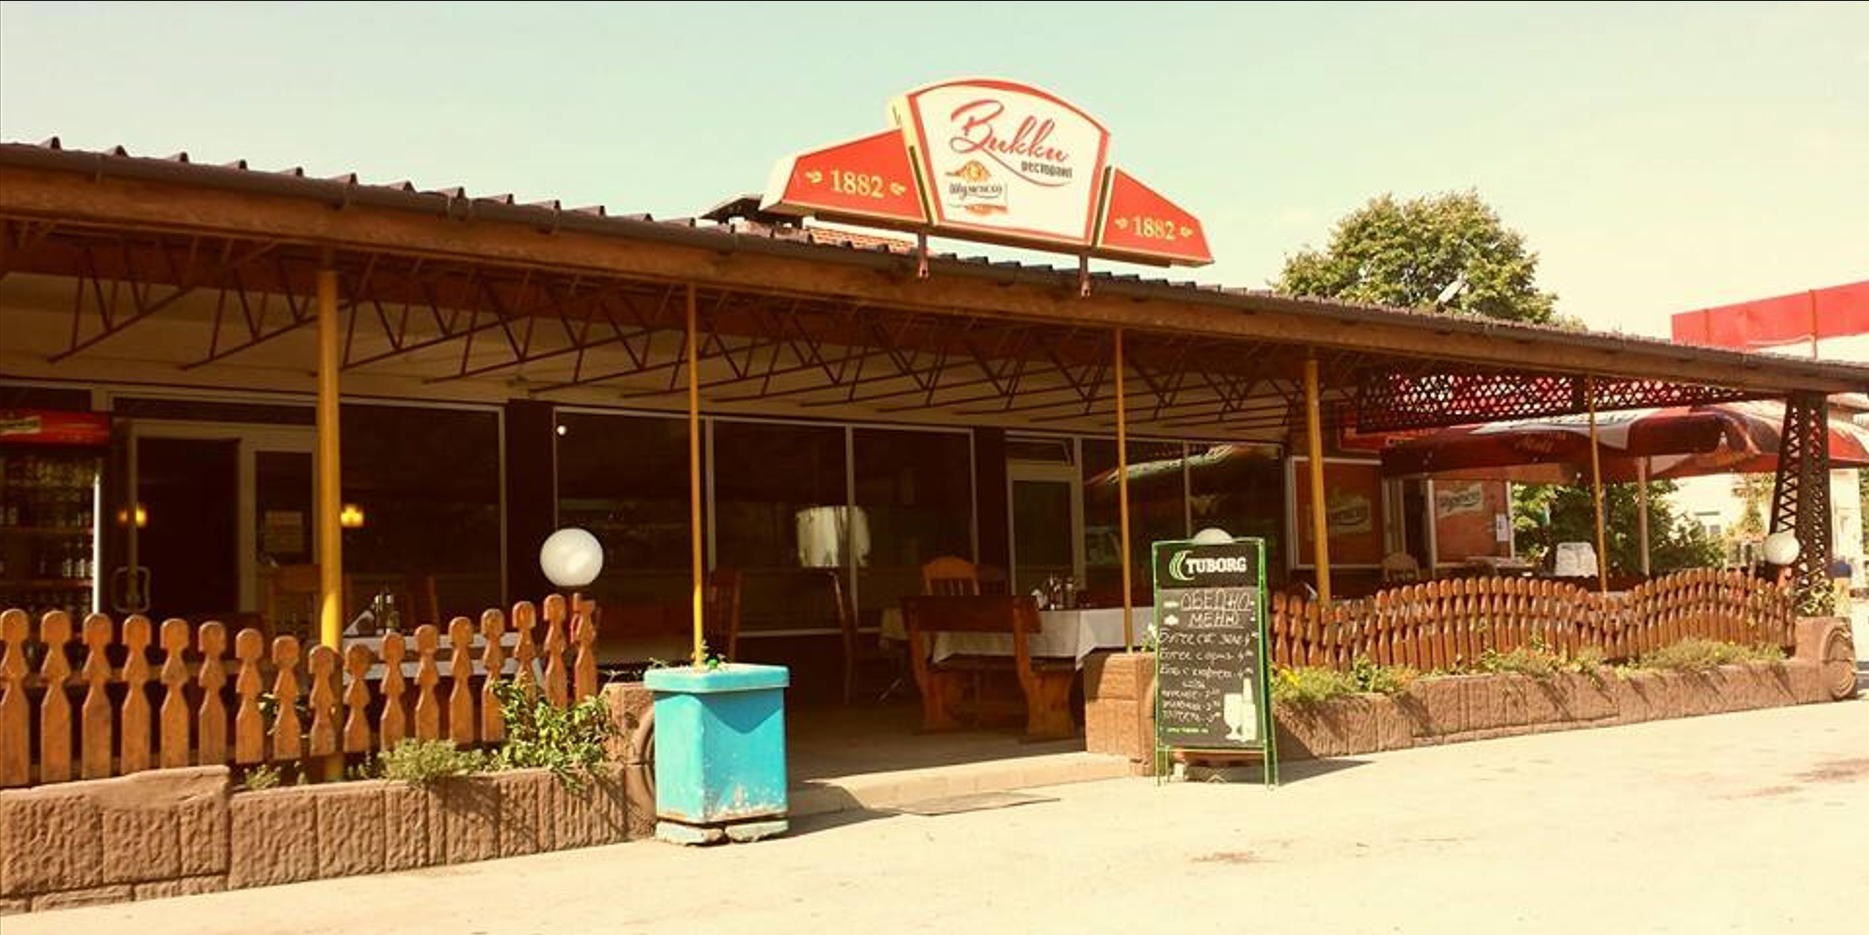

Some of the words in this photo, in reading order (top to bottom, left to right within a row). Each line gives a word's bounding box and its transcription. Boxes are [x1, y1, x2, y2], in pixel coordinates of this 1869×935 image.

[830, 170, 885, 199] 1882
[1134, 215, 1176, 240] 1882
[1187, 557, 1247, 574] TUBORG
